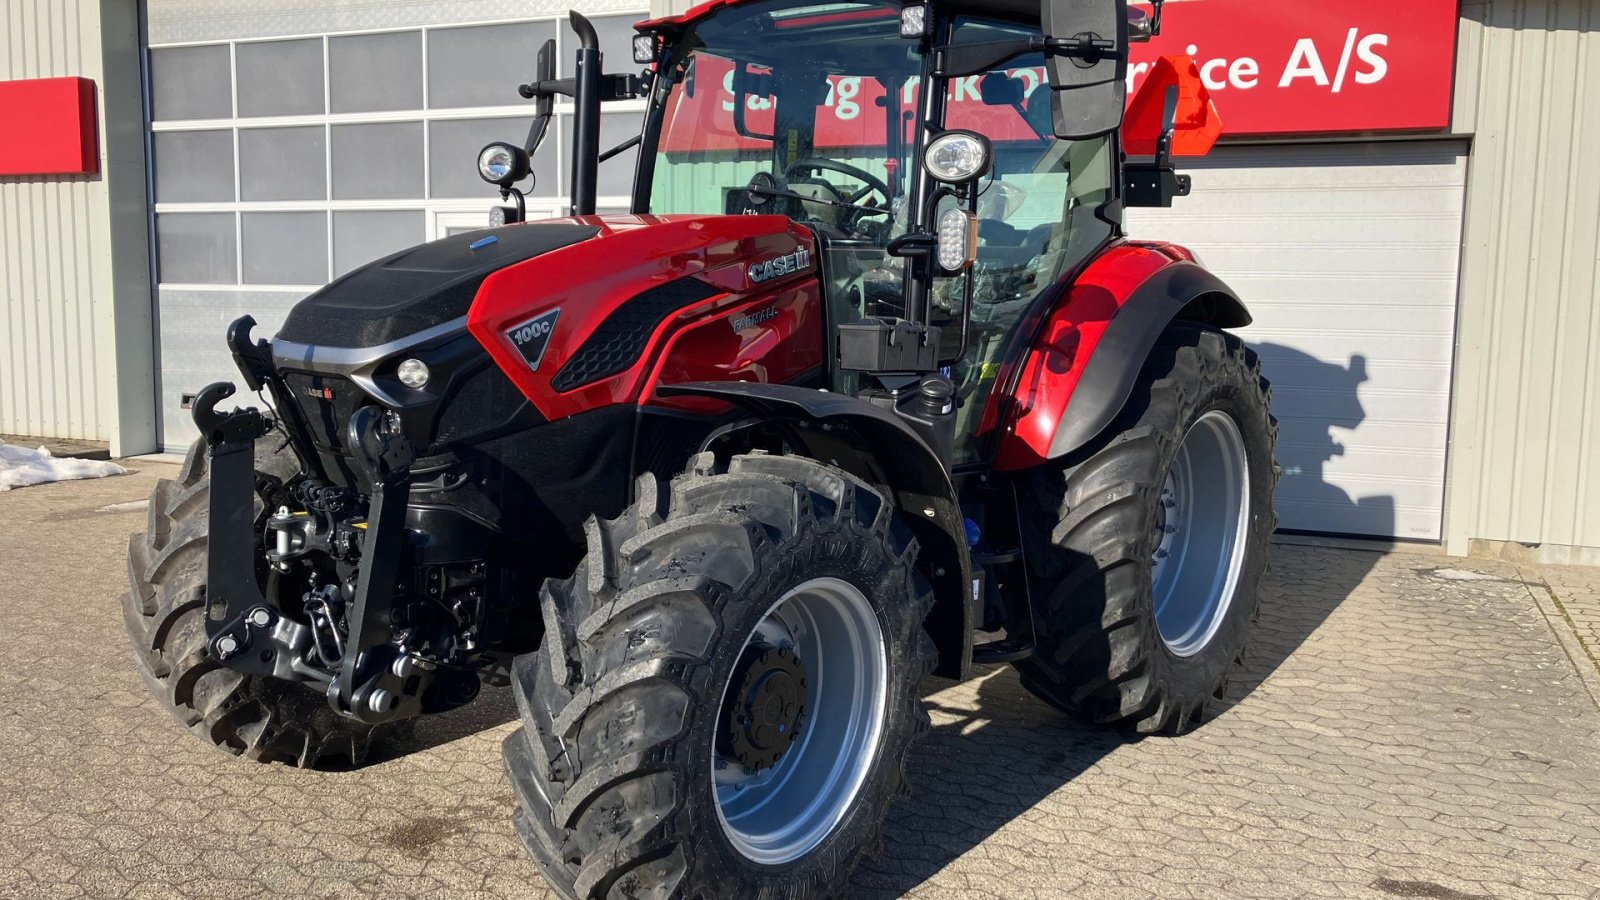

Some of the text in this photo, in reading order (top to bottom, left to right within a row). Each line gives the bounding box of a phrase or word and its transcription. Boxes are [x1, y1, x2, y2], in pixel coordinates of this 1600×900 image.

[1277, 27, 1389, 93] A/S
[748, 252, 796, 283] CASE
[733, 305, 779, 334] FARMALL
